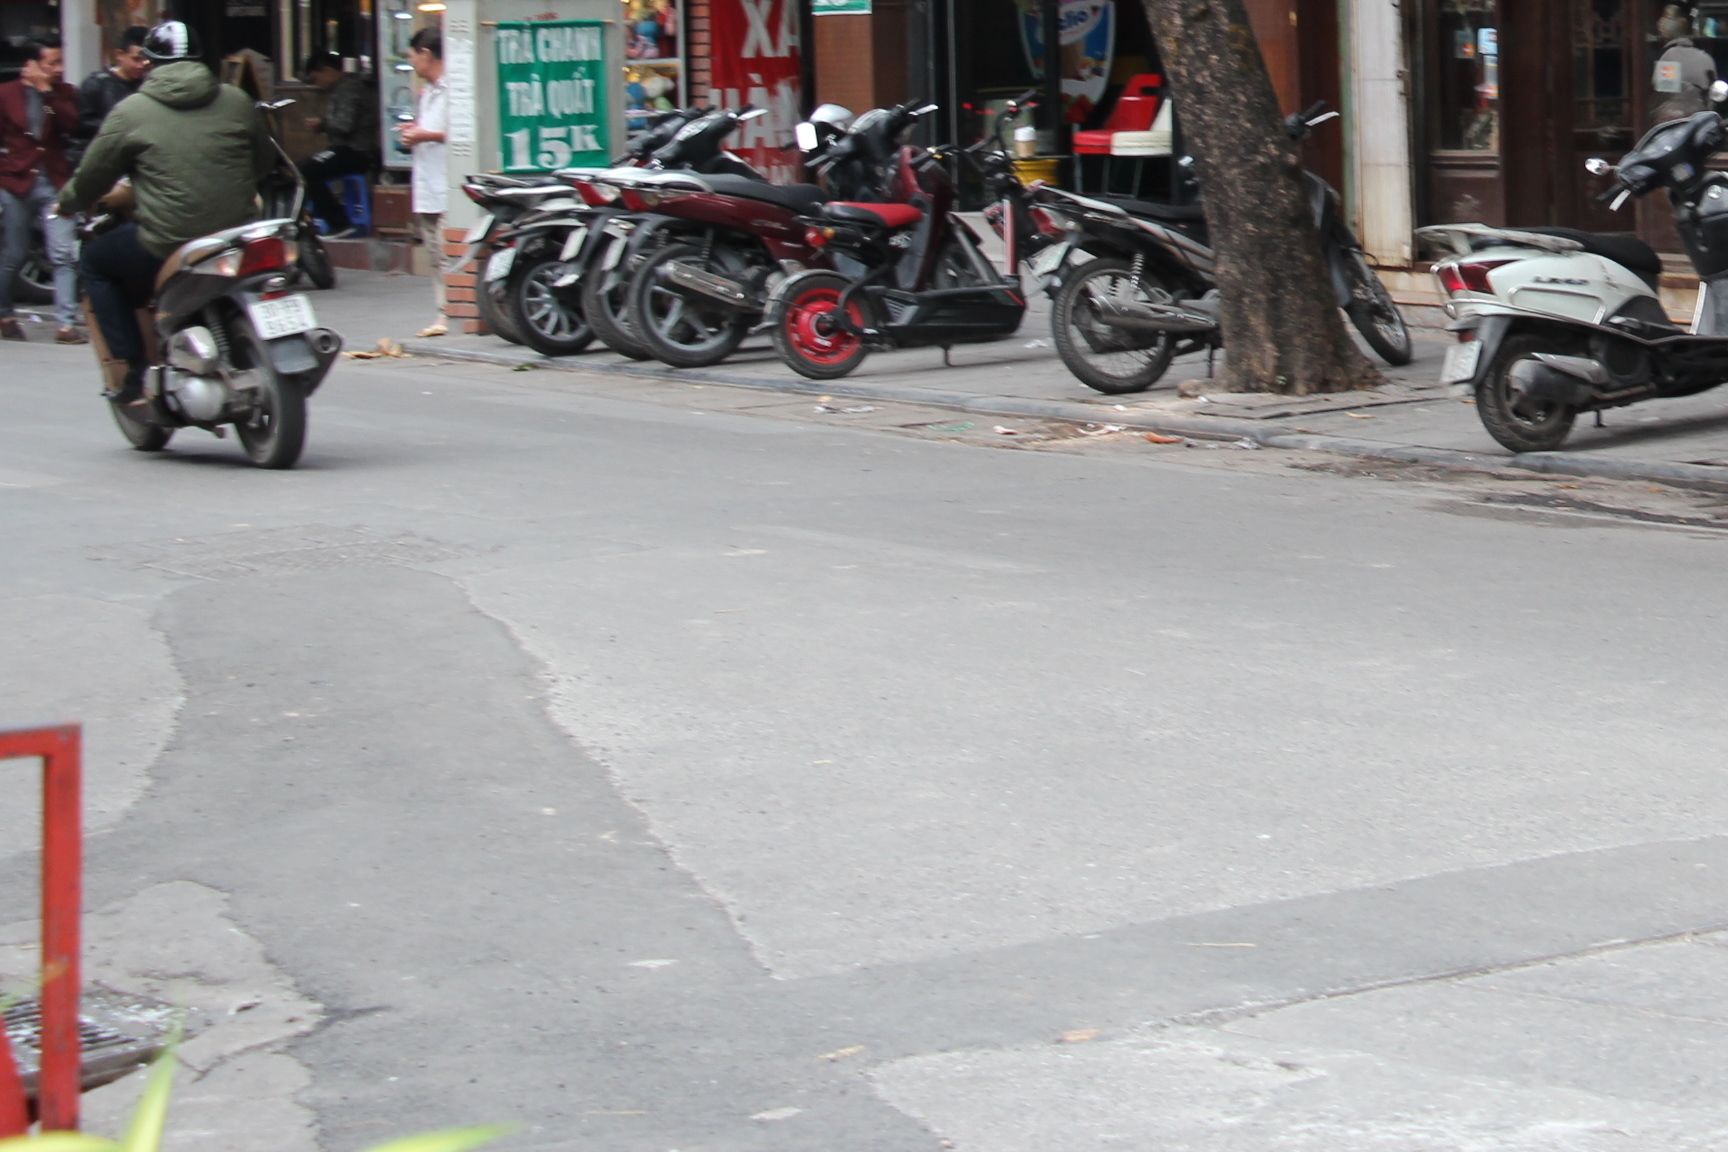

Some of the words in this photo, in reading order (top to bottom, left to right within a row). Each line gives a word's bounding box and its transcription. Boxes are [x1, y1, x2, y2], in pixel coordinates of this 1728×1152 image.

[536, 26, 603, 62] CHANH
[505, 72, 545, 118] TRÀ
[504, 124, 605, 171] 15K
